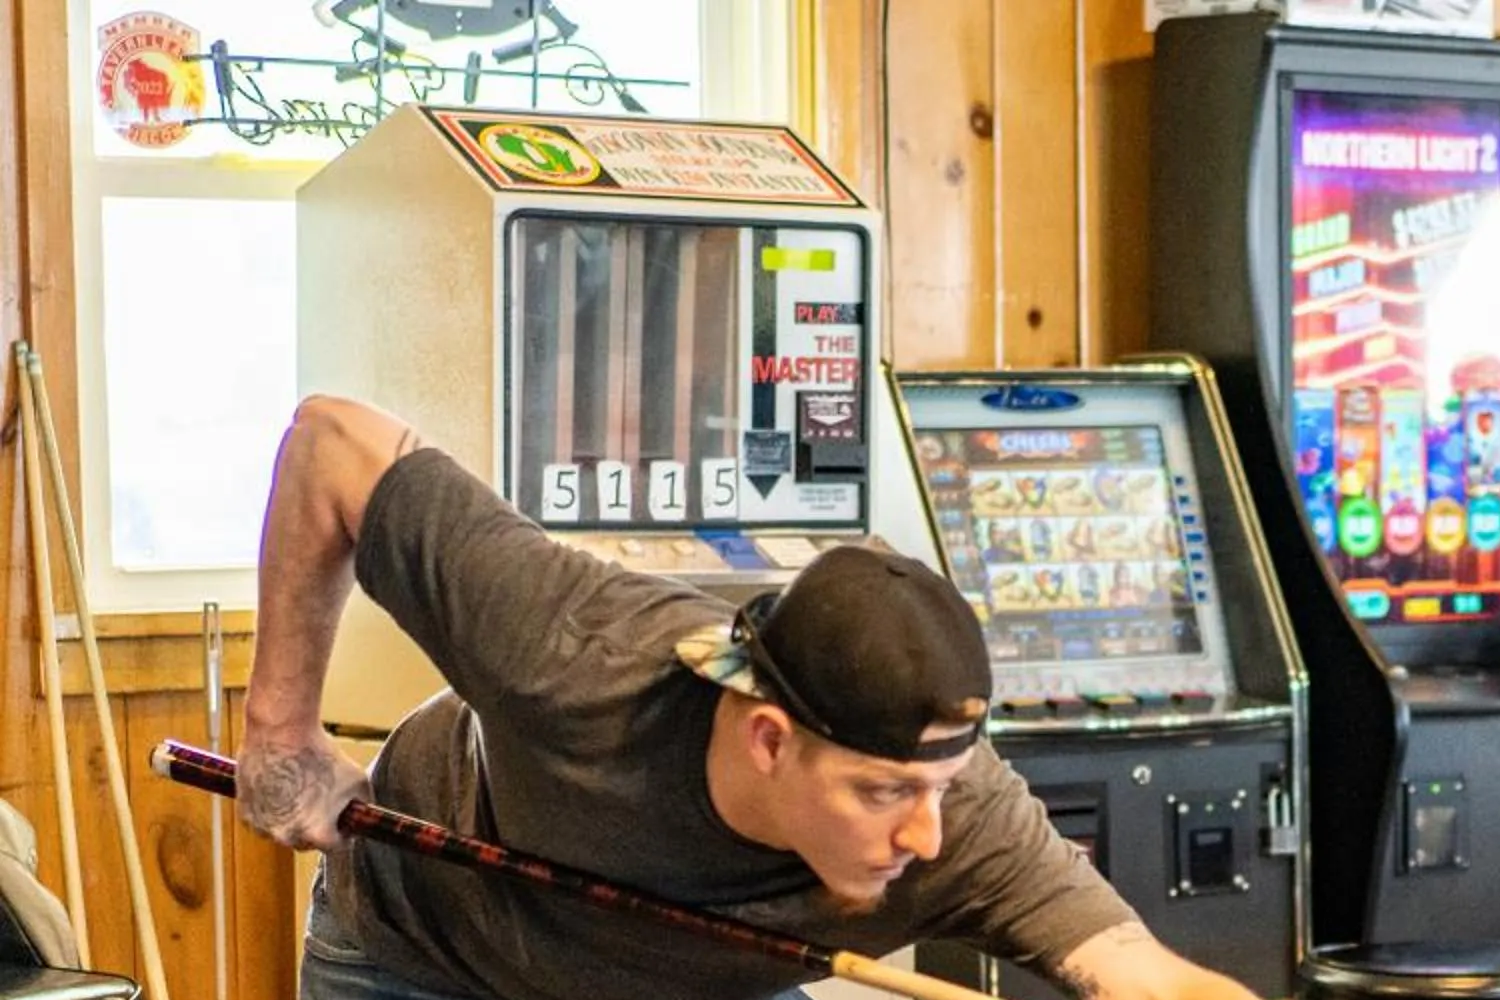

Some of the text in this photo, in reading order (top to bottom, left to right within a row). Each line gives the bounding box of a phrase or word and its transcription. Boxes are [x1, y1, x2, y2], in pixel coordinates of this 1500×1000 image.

[814, 335, 856, 353] THE
[751, 355, 860, 385] MASTER
[552, 470, 577, 510] 5
[607, 469, 628, 509] 1
[662, 470, 683, 510] 1
[713, 467, 736, 507] 5
